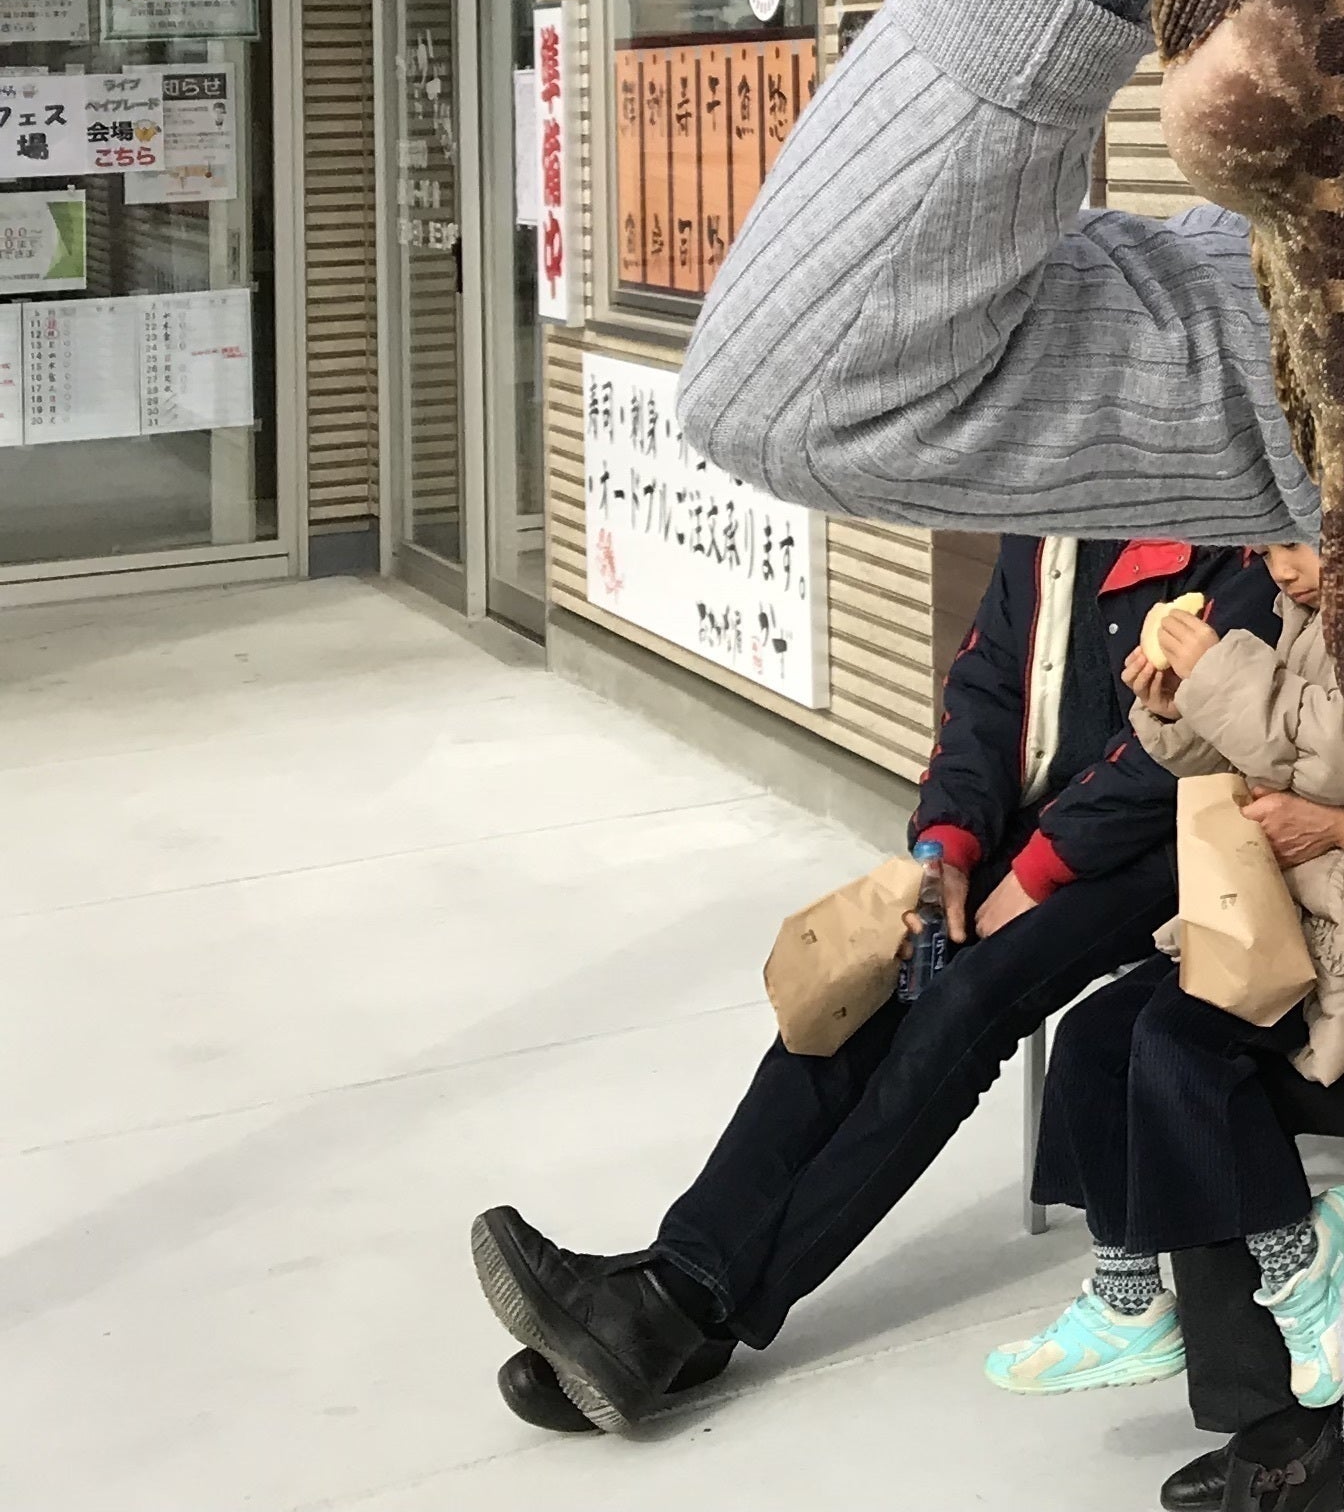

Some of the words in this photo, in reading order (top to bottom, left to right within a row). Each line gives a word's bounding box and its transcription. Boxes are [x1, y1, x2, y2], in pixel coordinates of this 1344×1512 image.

[87, 121, 134, 143] 会場
[95, 146, 156, 168] こちら
